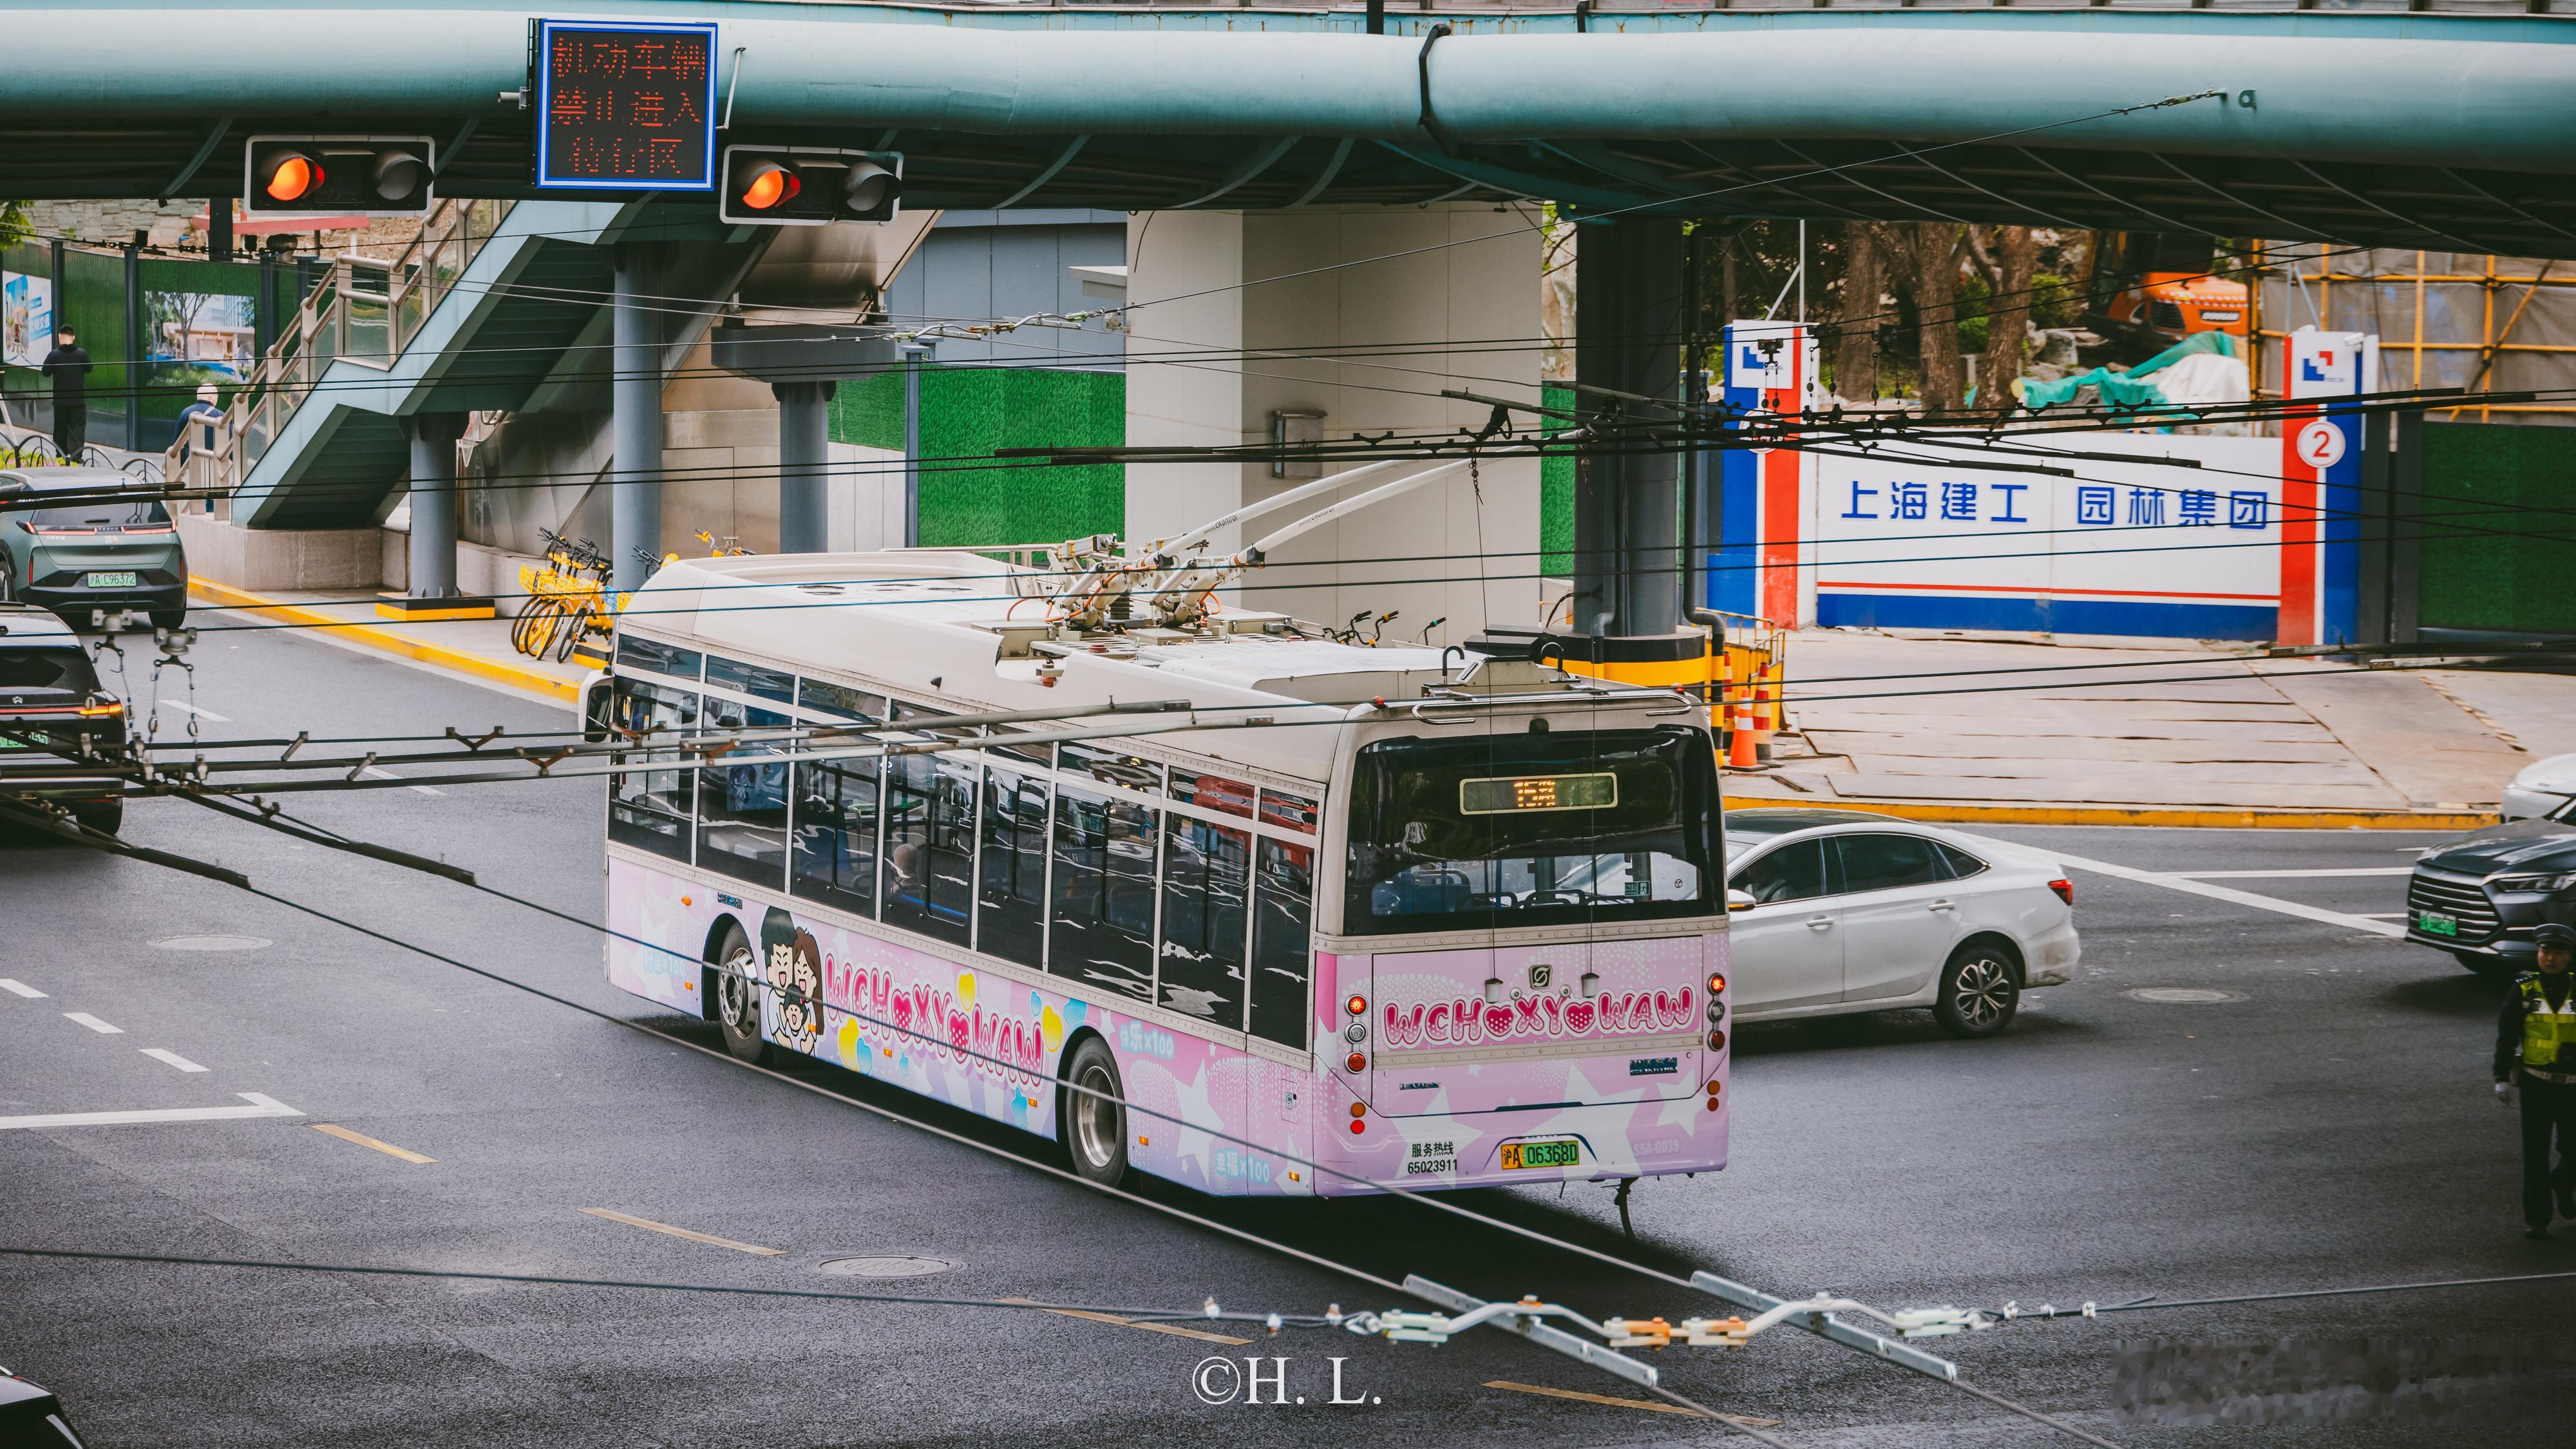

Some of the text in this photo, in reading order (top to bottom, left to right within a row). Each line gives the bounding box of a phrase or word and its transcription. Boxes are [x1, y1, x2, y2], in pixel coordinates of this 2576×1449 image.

[552, 37, 706, 80] 机动车辆
[551, 86, 702, 127] 禁止进入
[2313, 430, 2330, 458] 2
[1841, 480, 2268, 529] 上海建工 园林集团
[1411, 1141, 1454, 1157] 服务热线
[1633, 1138, 1680, 1157] S5A-0039
[1407, 1159, 1458, 1175] 65023911
